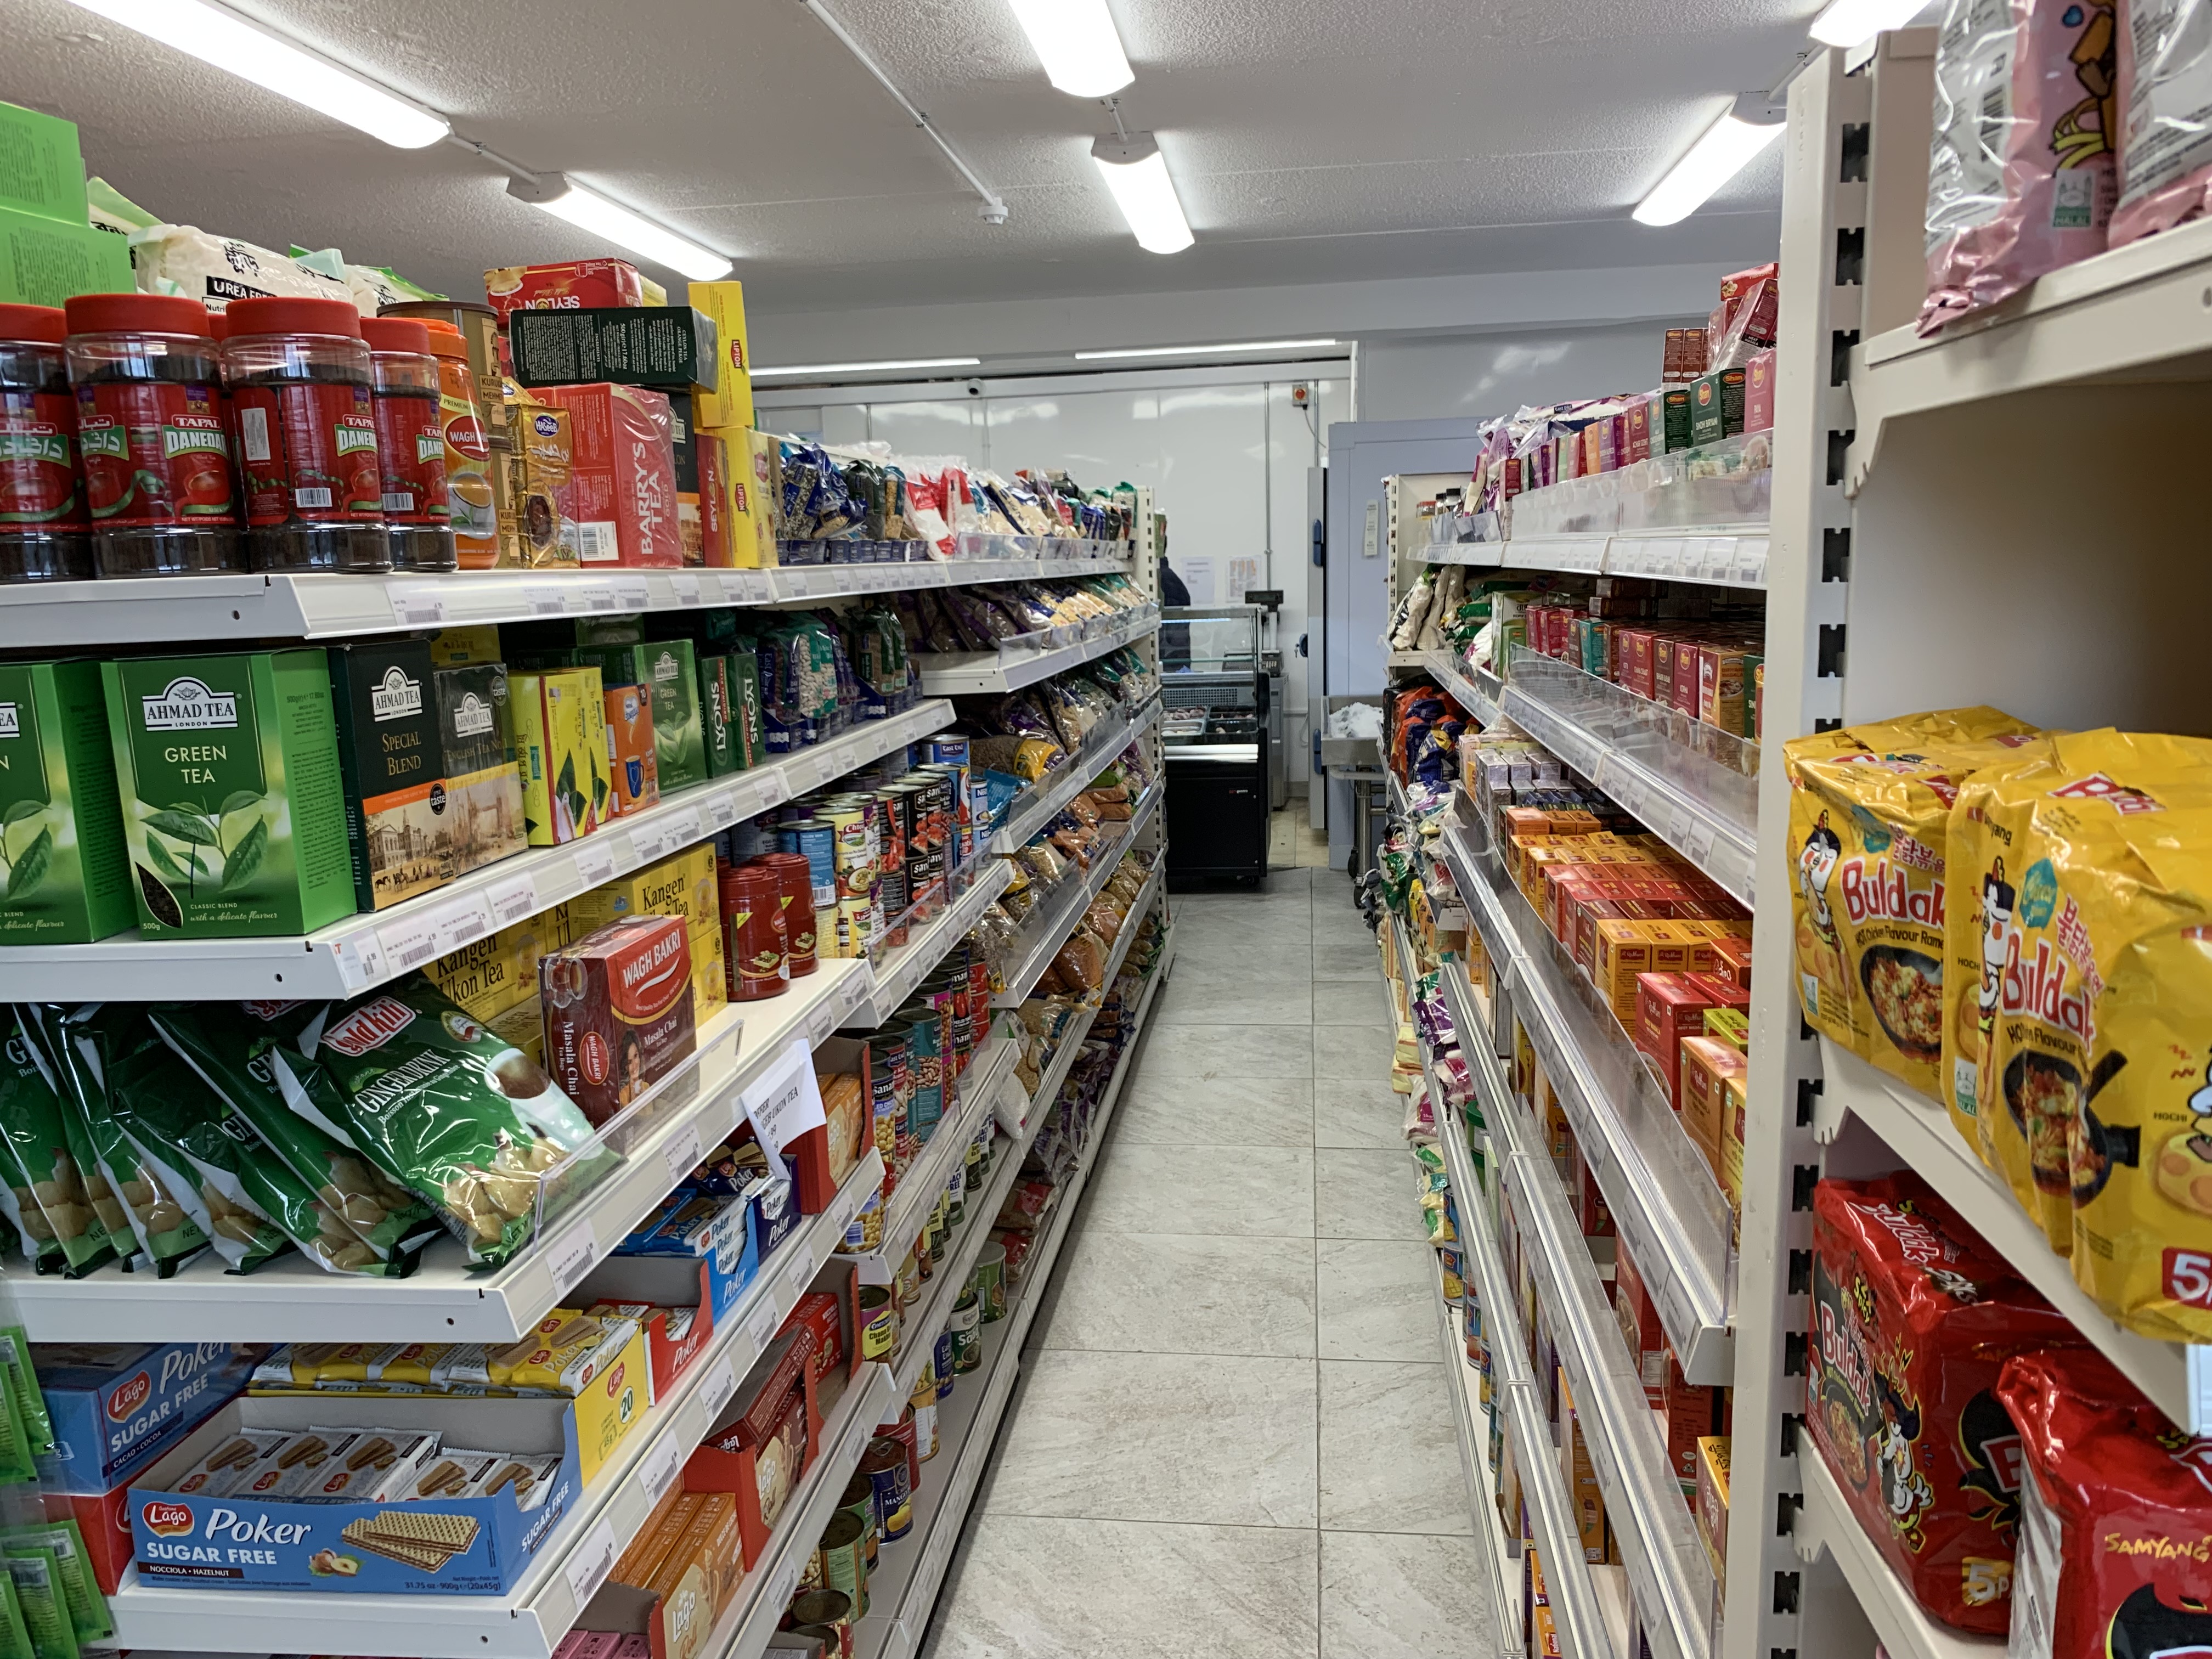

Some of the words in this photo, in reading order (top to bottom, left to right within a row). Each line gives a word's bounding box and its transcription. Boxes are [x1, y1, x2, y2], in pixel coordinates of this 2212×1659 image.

[214, 280, 247, 298] UREA
[1725, 374, 1743, 382] Shan
[444, 398, 468, 409] PREMIUM
[175, 417, 220, 428] TAPAL
[676, 426, 685, 436] TEA
[450, 431, 475, 443] WAGH
[633, 442, 654, 554] BARRY'S
[648, 471, 663, 529] TEA
[708, 471, 718, 532] SEYLON
[376, 693, 404, 710] AHMAD
[405, 690, 420, 704] TEA
[493, 686, 506, 696] taste
[660, 689, 676, 698] GREEN
[147, 704, 202, 720] AHMAD
[205, 703, 234, 718] TEA
[665, 702, 674, 710] TEA
[712, 682, 726, 751] LYONS
[744, 679, 759, 743] LYONS
[457, 715, 477, 729] AHMAD
[478, 713, 490, 723] TEA
[165, 746, 227, 763] GREEN
[182, 769, 216, 784] TEA
[431, 794, 445, 806] taste
[642, 877, 685, 911] Kangen
[190, 913, 207, 921] with
[217, 912, 246, 921] delicate
[248, 911, 278, 922] flavour
[673, 898, 689, 917] Tea
[4, 919, 33, 929] delicate
[35, 919, 64, 932] flavour
[143, 922, 160, 931] 500g
[1885, 926, 1919, 944] Flavour
[437, 934, 498, 979] Kangen
[623, 951, 652, 989] WAGH
[654, 929, 681, 967] BAKRI
[439, 975, 479, 1003] Ukon
[479, 960, 505, 989] Tea
[563, 1022, 574, 1063] Masala
[644, 1028, 664, 1047] Masala
[664, 1017, 678, 1032] Chai
[2035, 1027, 2077, 1054] Flavour
[588, 1036, 599, 1058] WAGH
[592, 1058, 602, 1079] BAKRI
[567, 1067, 580, 1095] Chai
[378, 1099, 403, 1125] Boisson
[772, 1097, 786, 1119] UKON
[787, 1087, 798, 1103] TEA
[2154, 1113, 2188, 1122] HOCHI
[728, 1168, 754, 1192] Poker
[767, 1195, 782, 1216] Poker
[669, 1217, 700, 1240] Poker
[712, 1215, 730, 1240] Poker
[769, 1215, 790, 1247] Poker
[724, 1268, 747, 1304] Poker
[543, 1344, 580, 1373] Poker
[570, 1351, 589, 1370] LIMONE
[596, 1343, 617, 1374] Poker
[673, 1333, 699, 1372] Poker
[160, 1342, 225, 1394] Poker
[610, 1367, 623, 1391] Lago
[113, 1378, 145, 1413] Lago
[621, 1389, 633, 1420] 20
[112, 1402, 170, 1453] SUGAR
[175, 1374, 208, 1408] FREE
[114, 1449, 136, 1468] CACAO
[140, 1431, 161, 1449] COCOA
[759, 1462, 776, 1497] Lago
[150, 1504, 187, 1526] Lago
[206, 1508, 312, 1545] Poker
[522, 1511, 551, 1552] SUGAR
[552, 1481, 569, 1513] FREE
[147, 1543, 222, 1564] SUGAR
[228, 1549, 277, 1565] FREE
[2105, 1533, 2211, 1562] SAMYANG
[150, 1565, 187, 1575] NOCCIOLA
[404, 1581, 425, 1589] 31.75
[439, 1582, 460, 1591] 900g
[467, 1581, 501, 1592] (20x45g)
[673, 1590, 695, 1643] Lago
